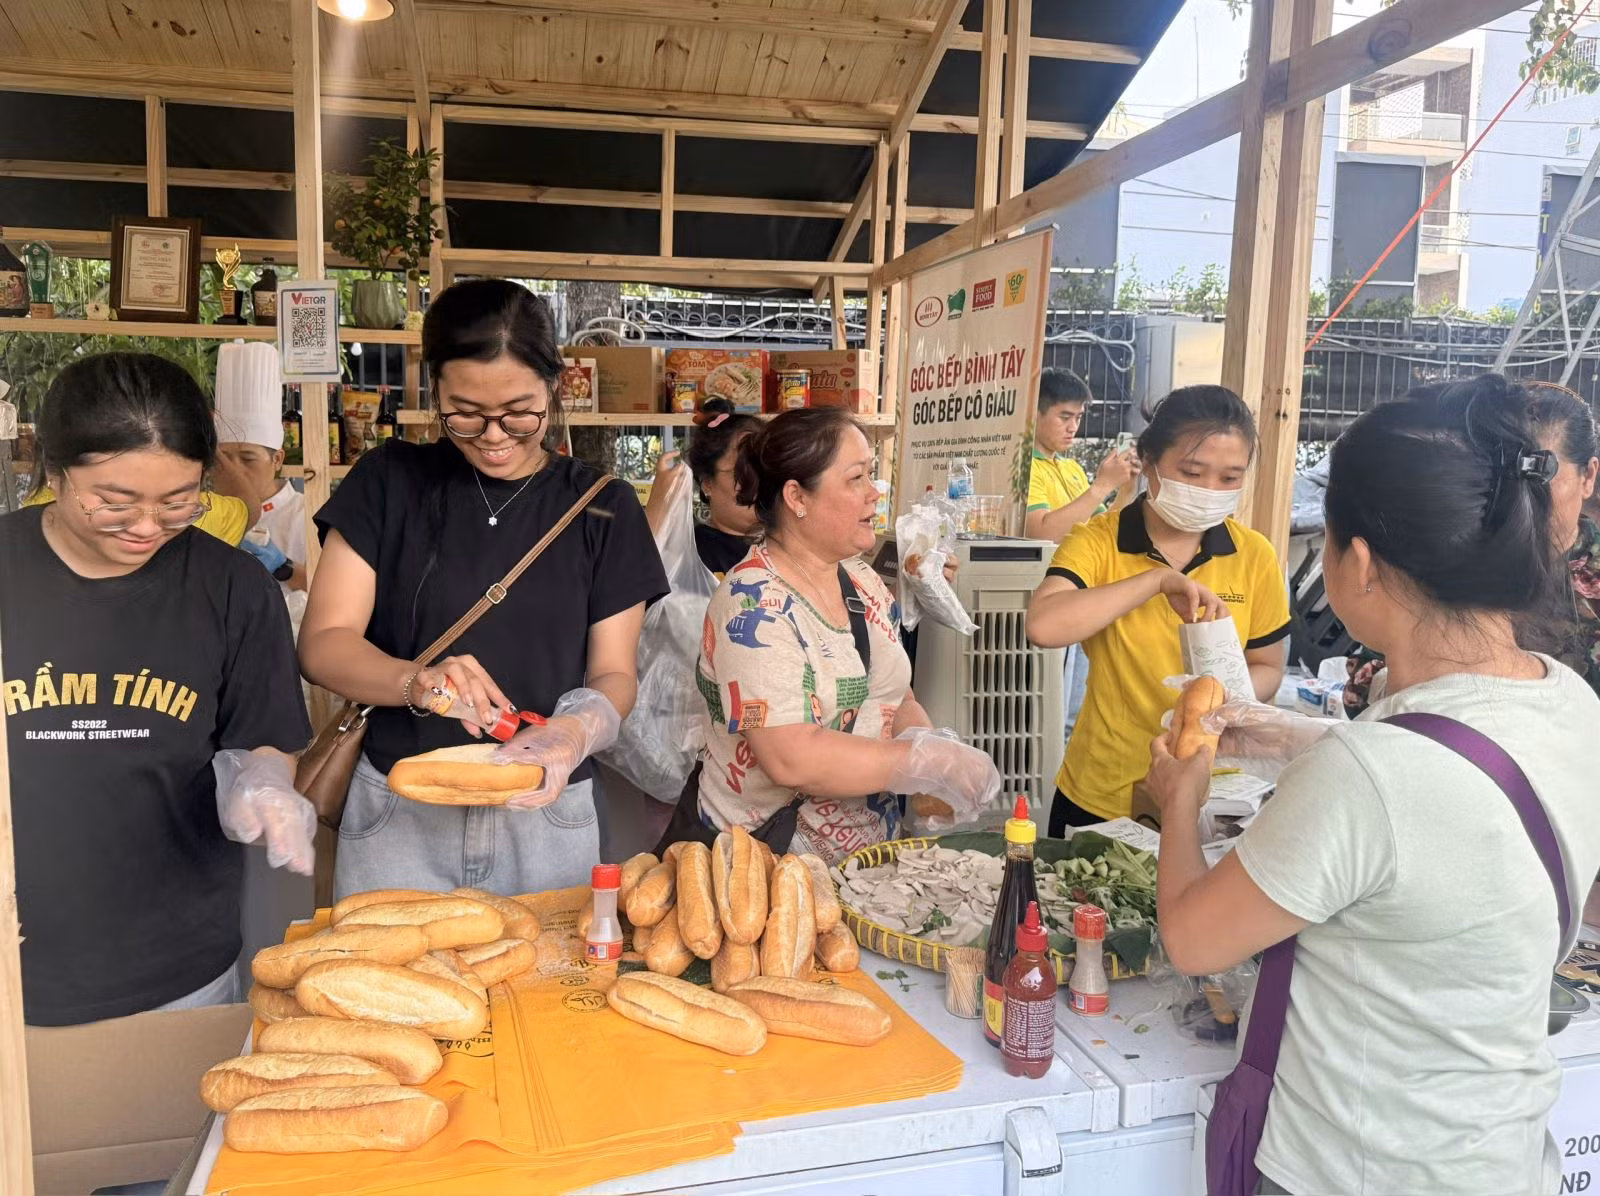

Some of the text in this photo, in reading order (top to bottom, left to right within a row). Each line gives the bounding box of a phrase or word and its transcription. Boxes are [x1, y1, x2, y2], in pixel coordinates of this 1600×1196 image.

[975, 292, 992, 303] FOOD
[911, 344, 1026, 393] GÓC BẾP BÌNH TÂY
[913, 385, 1017, 425] GÓC BẾP CÔ GIÀU
[113, 668, 198, 722] TÍNH
[26, 729, 150, 740] BLACKWORK STREETWEAR
[72, 720, 107, 729] SS2022
